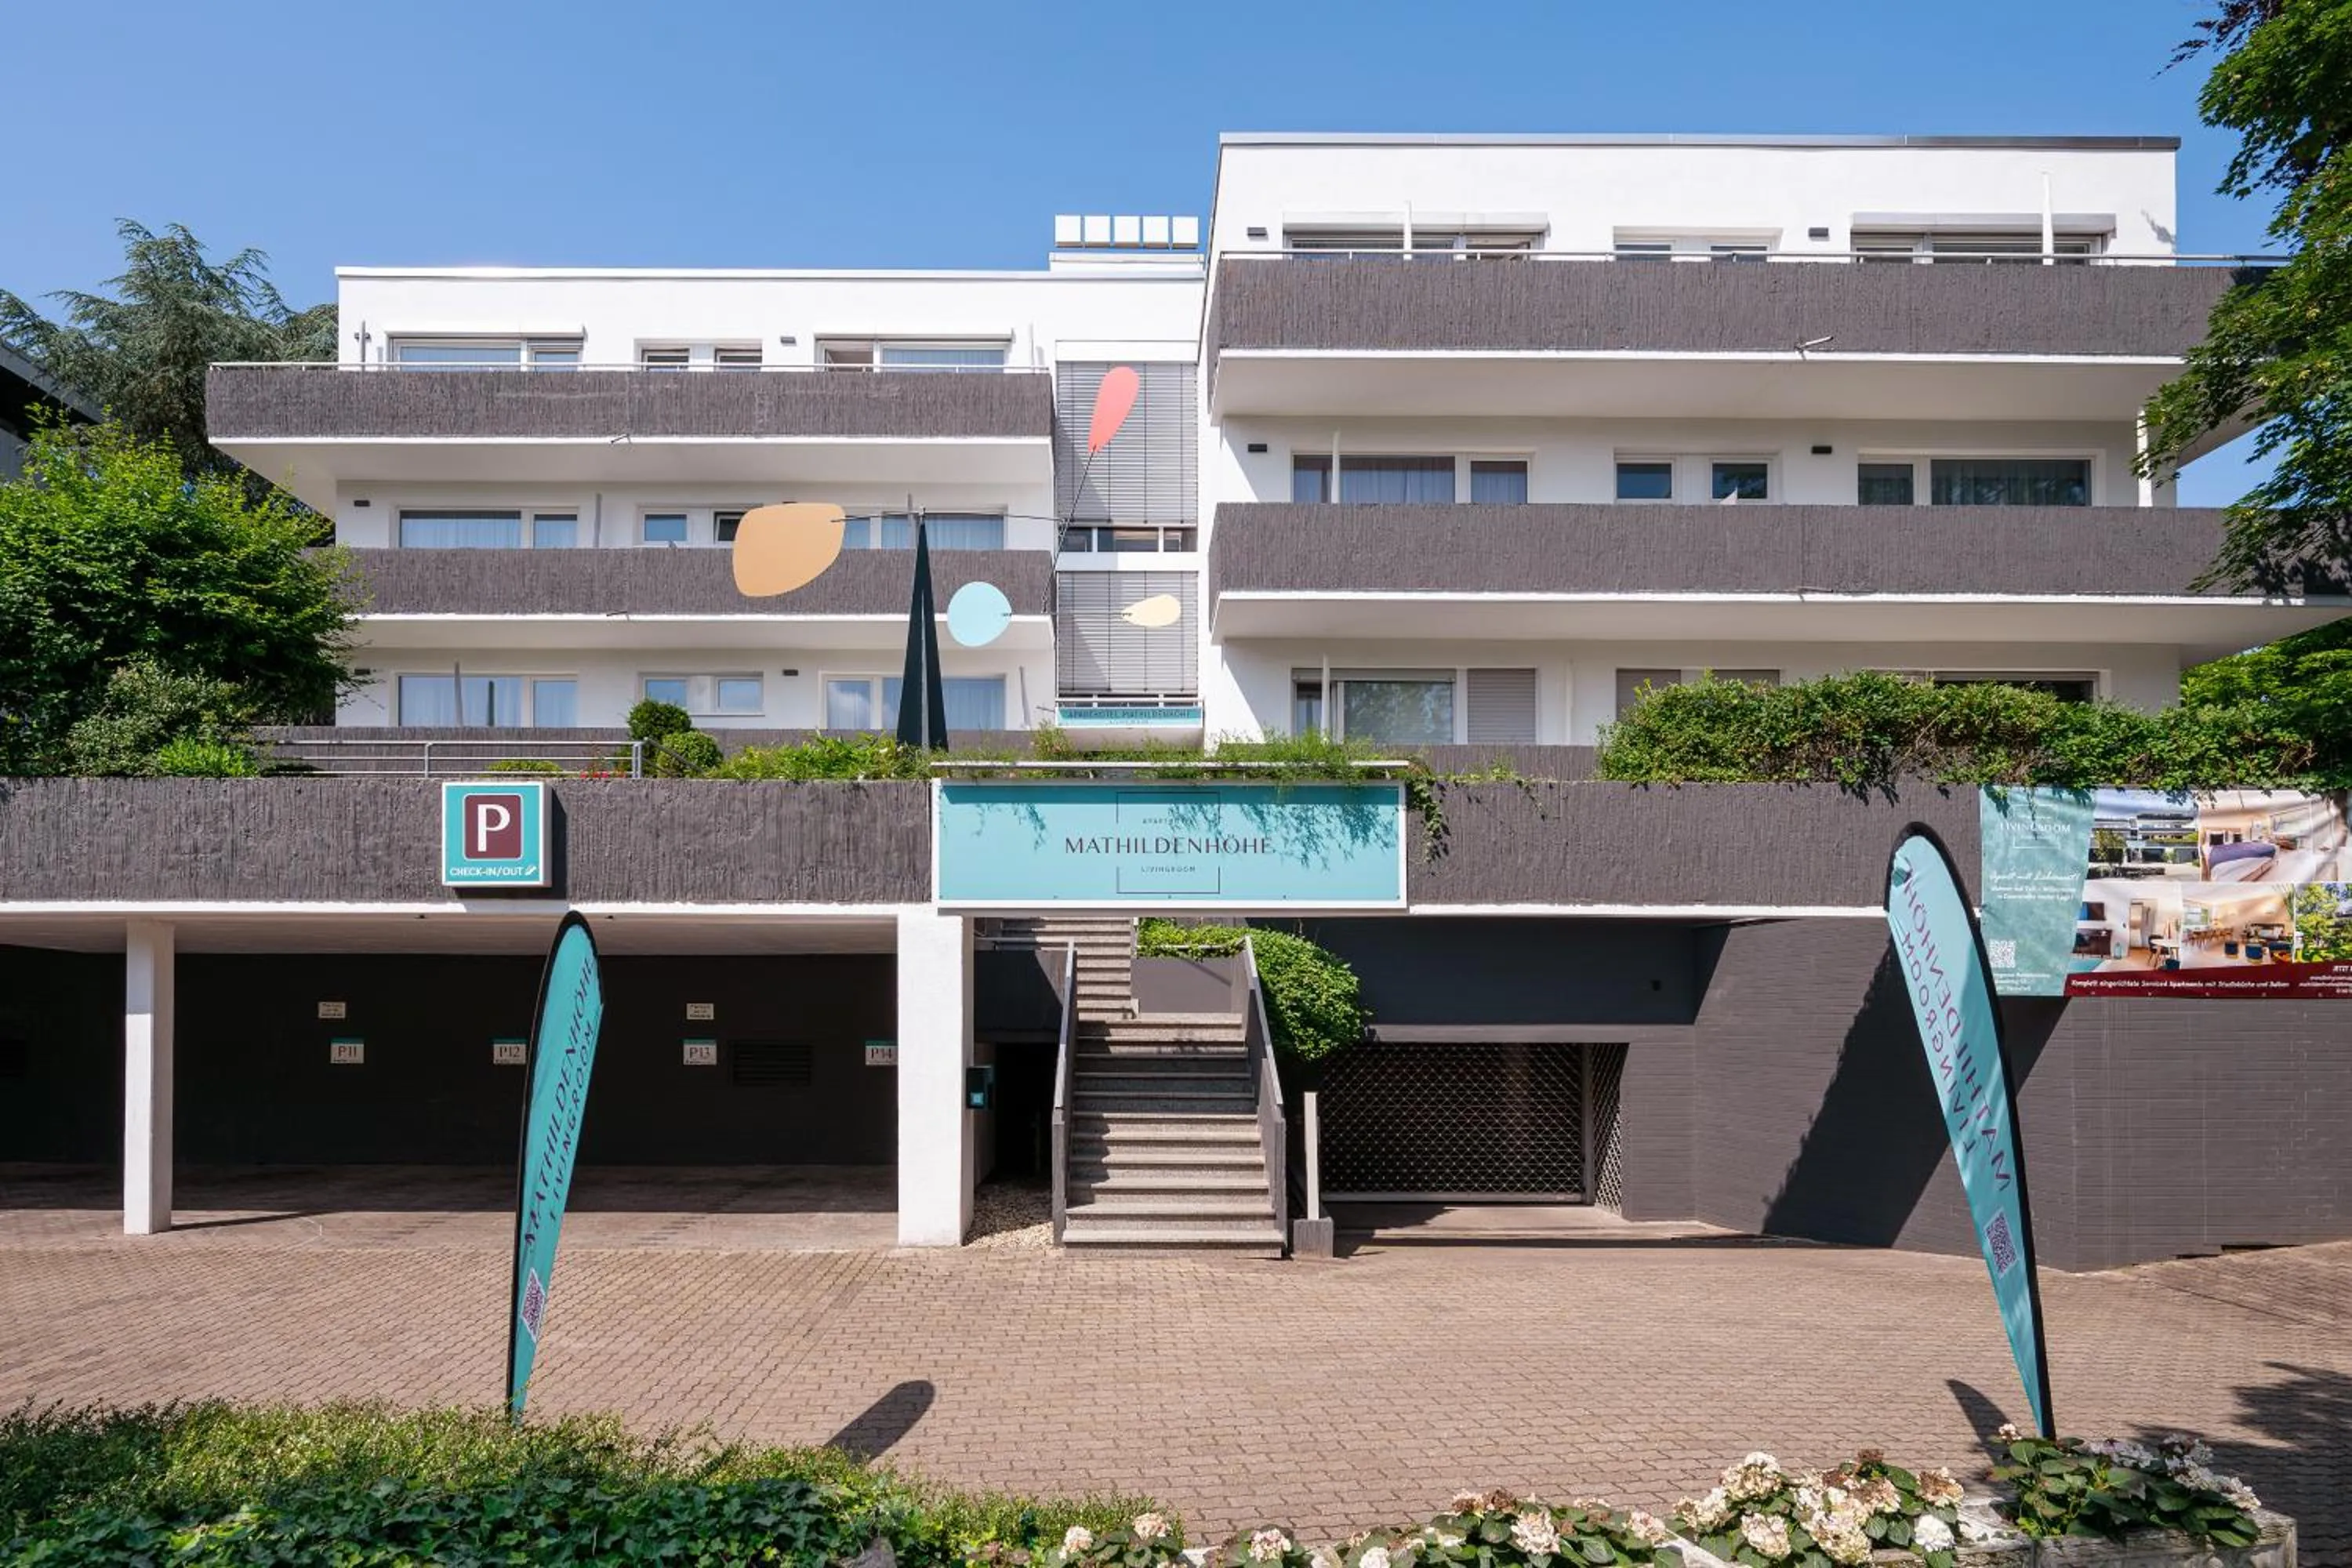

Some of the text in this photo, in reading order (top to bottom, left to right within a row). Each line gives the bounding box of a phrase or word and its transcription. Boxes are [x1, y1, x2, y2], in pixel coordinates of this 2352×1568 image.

[477, 804, 510, 852] P
[1065, 834, 1273, 854] MATHILDENHÖHE
[449, 866, 523, 877] CHECK-IN/OUT
[499, 1047, 521, 1058] P12
[550, 1020, 593, 1221] LIVINGROOM
